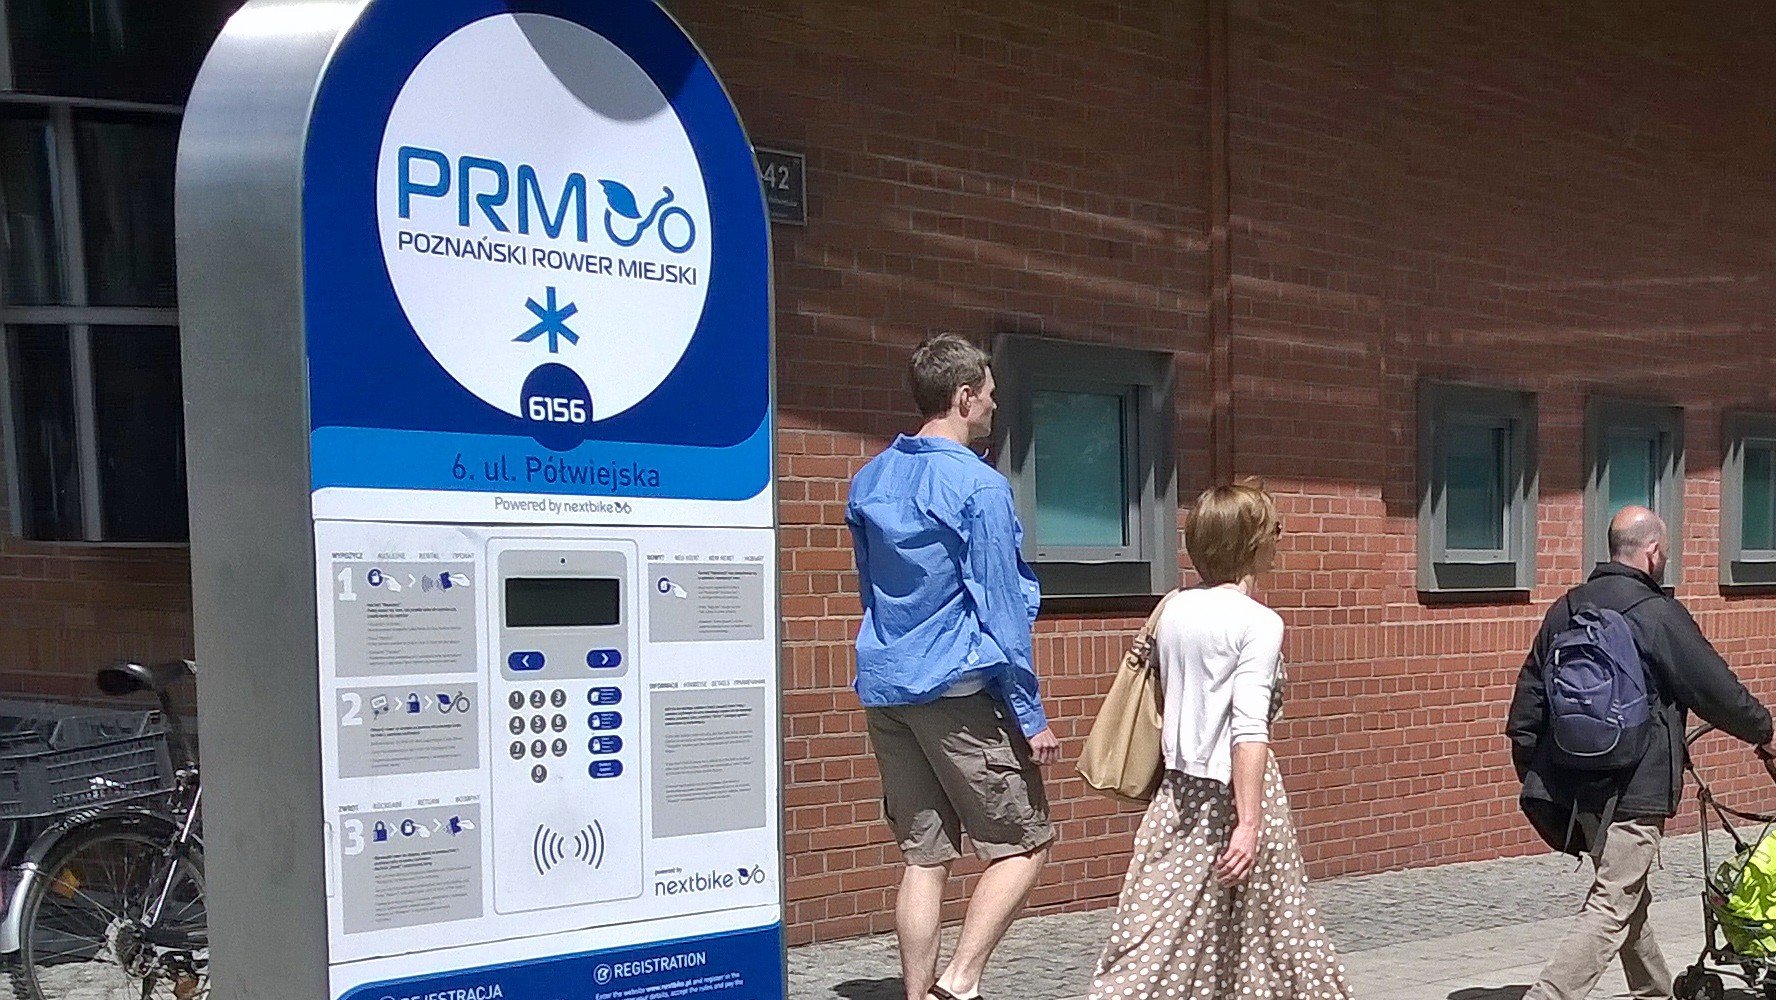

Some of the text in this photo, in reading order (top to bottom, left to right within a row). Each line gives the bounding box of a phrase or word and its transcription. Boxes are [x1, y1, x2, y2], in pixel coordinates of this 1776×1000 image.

[762, 161, 790, 191] 42
[397, 145, 587, 243] PRM
[398, 231, 698, 286] POZNAŃSKI ROWER MIEJSKI
[528, 396, 586, 424] 6156
[452, 455, 476, 482] 6.
[484, 456, 518, 484] ul.
[494, 498, 613, 516] Powered by nextbike
[338, 567, 357, 601] 1
[341, 692, 363, 727] 2
[344, 819, 365, 856] 3
[655, 869, 734, 897] nextbike
[613, 951, 706, 979] REGISTRATION
